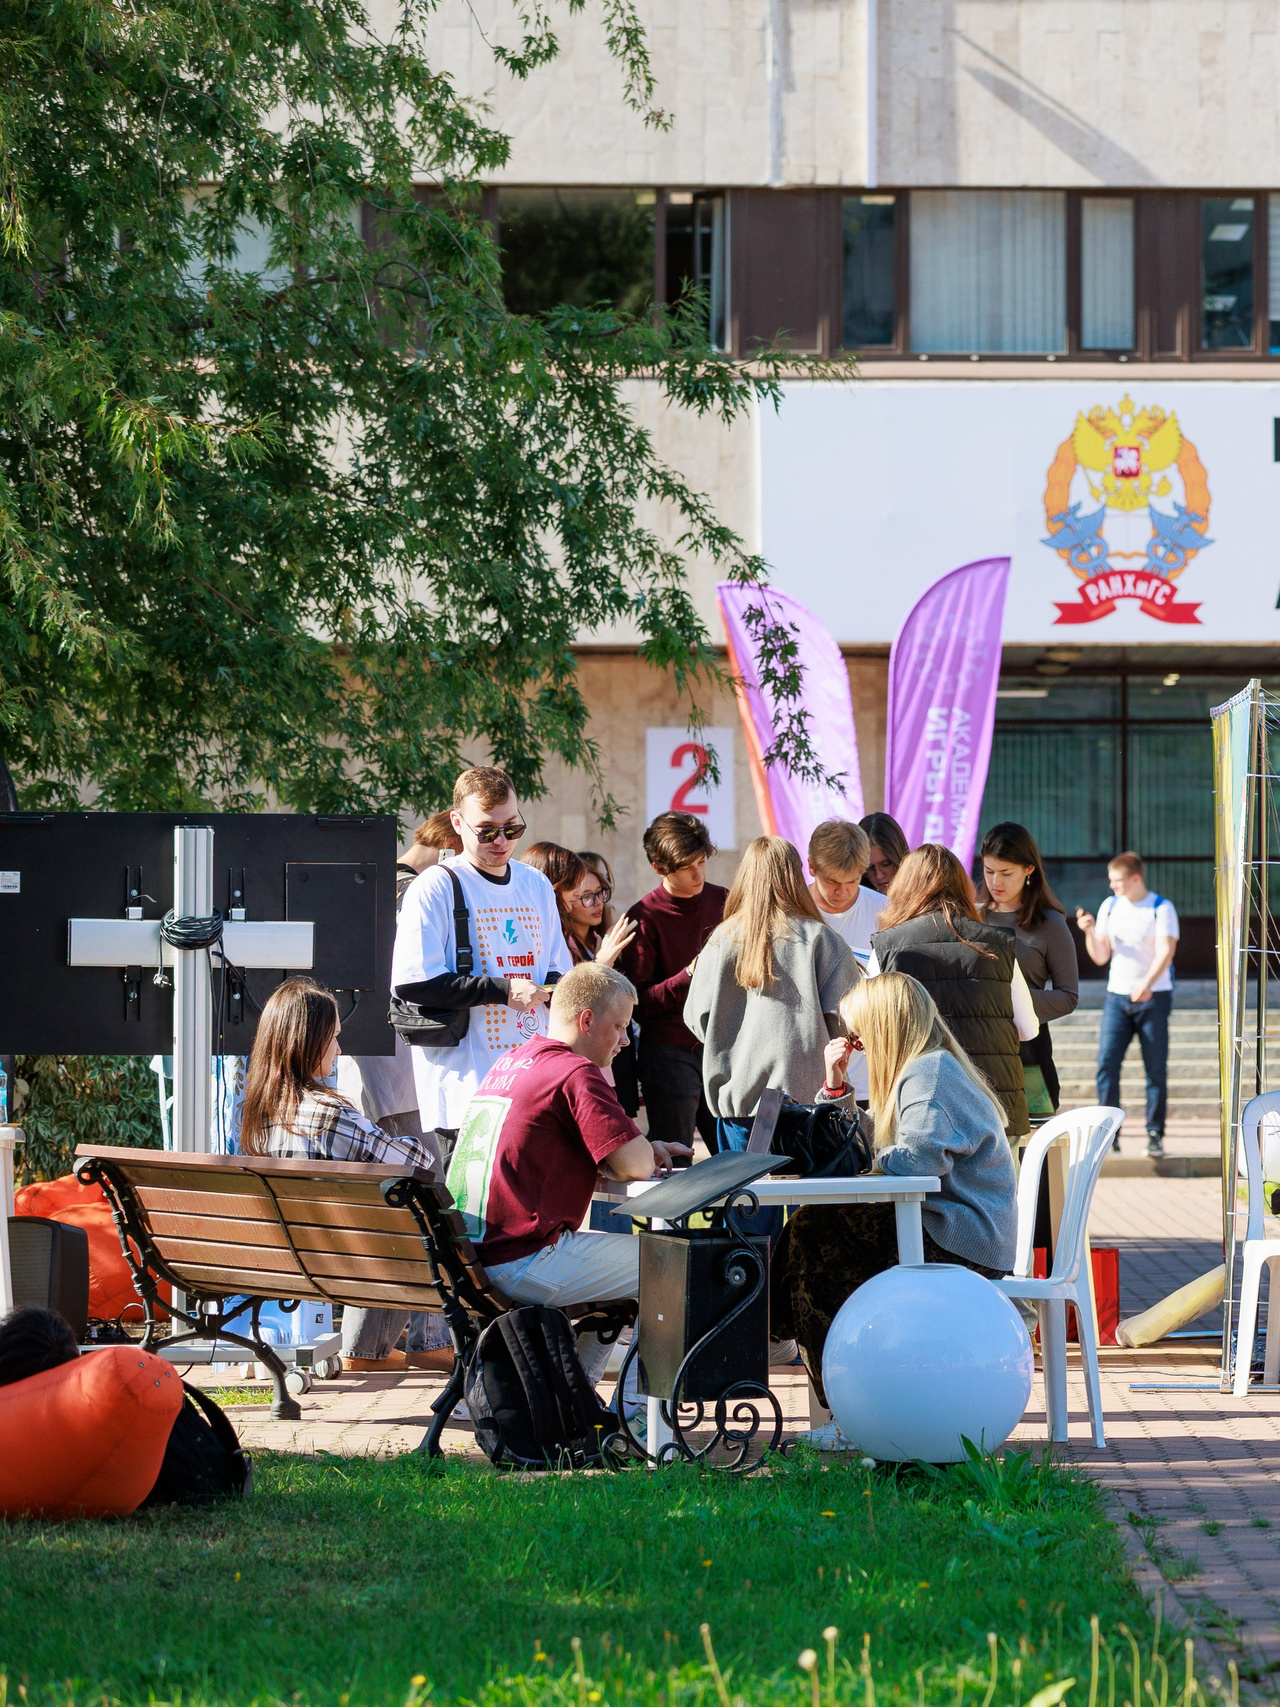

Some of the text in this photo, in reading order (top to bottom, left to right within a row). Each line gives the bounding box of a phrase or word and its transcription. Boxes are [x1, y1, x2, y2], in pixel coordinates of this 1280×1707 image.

[670, 743, 711, 814] 2
[496, 951, 535, 967] Я ГЕРОЙ
